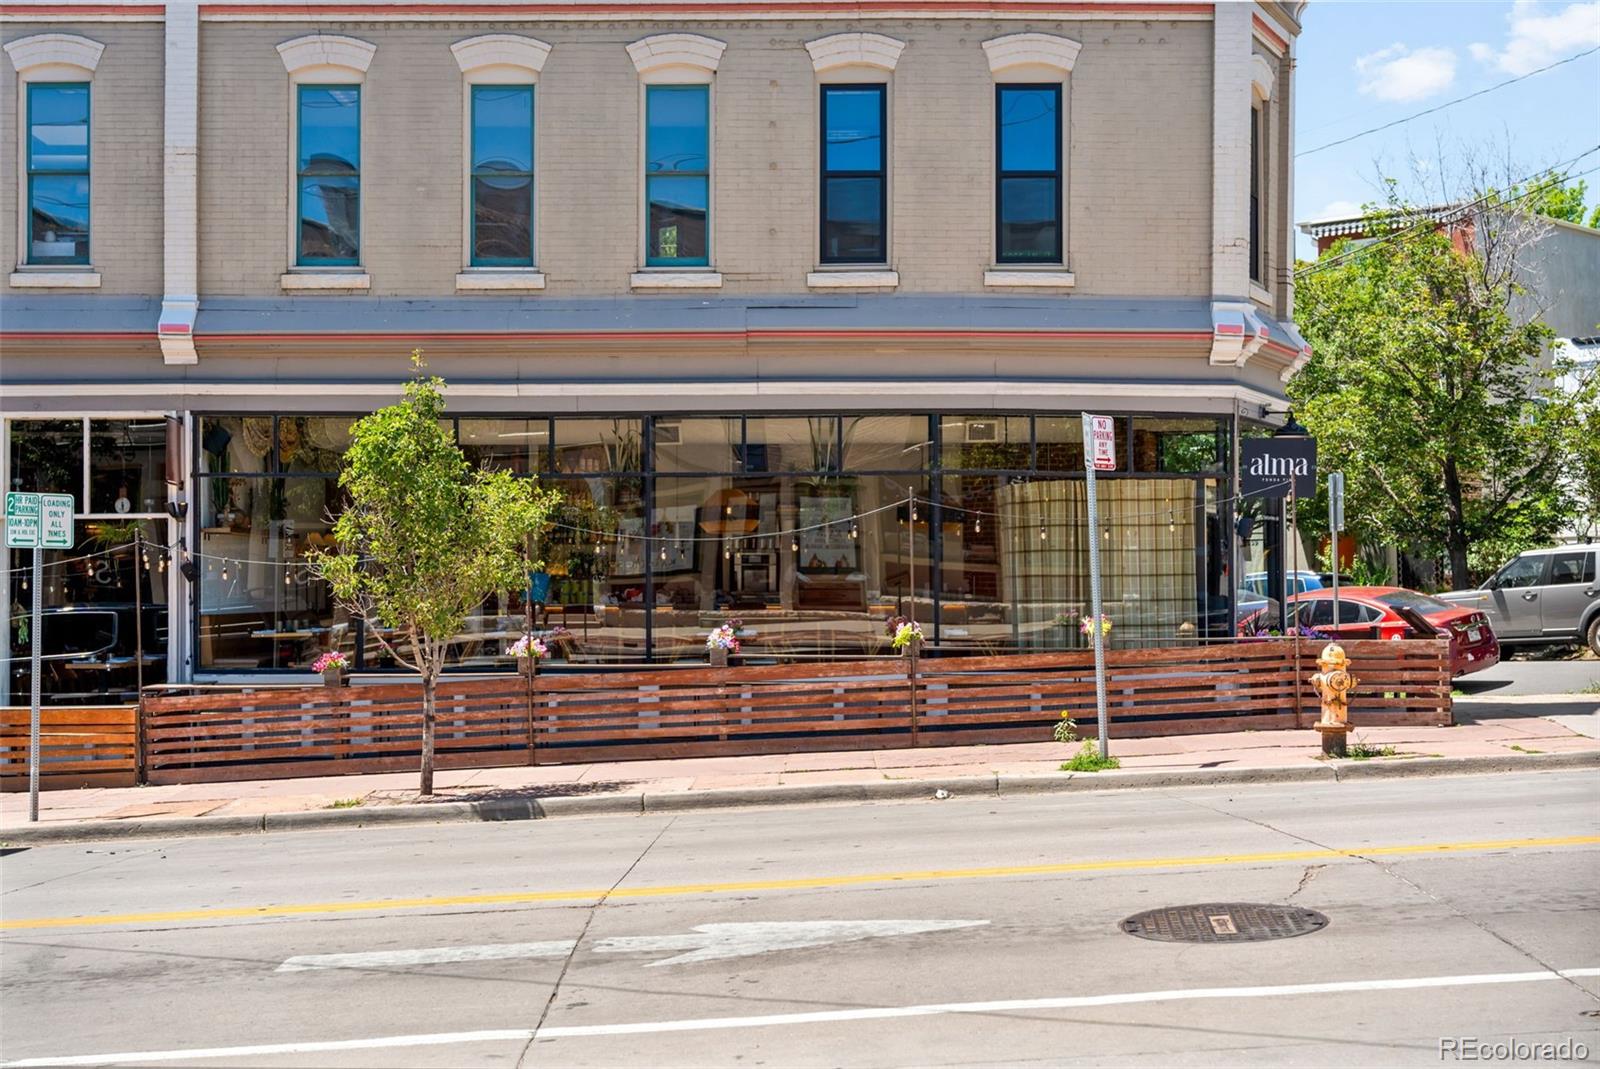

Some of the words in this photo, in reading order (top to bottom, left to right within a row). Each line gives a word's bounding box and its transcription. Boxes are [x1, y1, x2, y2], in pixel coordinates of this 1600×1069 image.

[1097, 420, 1107, 430] NO
[1093, 431, 1113, 441] PARKING
[1250, 454, 1308, 476] alma
[8, 497, 15, 512] 2
[15, 495, 24, 504] HR
[25, 496, 38, 505] PAID
[43, 499, 71, 508] LOADING
[15, 505, 38, 514] PARKING
[48, 510, 65, 518] ONLY
[51, 520, 62, 528] ALL
